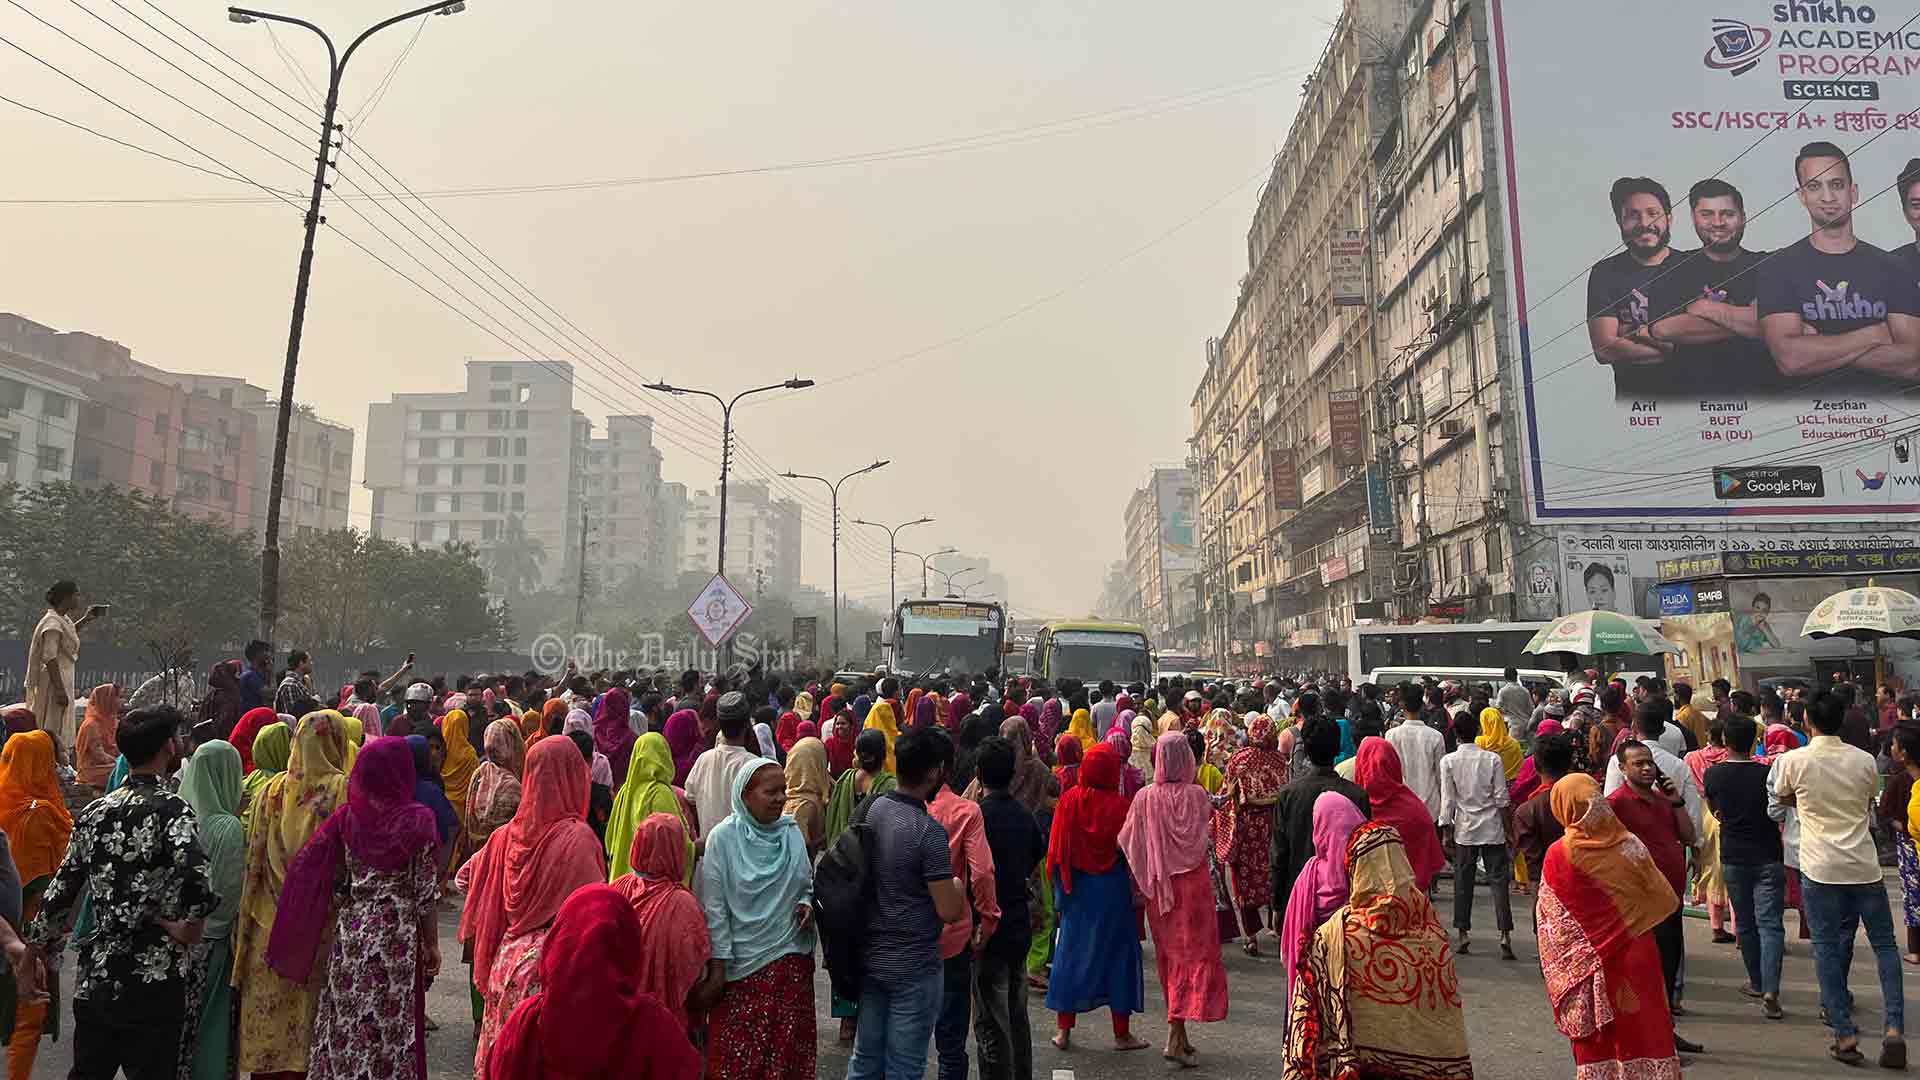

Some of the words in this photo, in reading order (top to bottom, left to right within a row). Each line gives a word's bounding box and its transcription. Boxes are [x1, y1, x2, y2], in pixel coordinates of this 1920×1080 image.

[1774, 0, 1876, 23] shikho
[1778, 30, 1920, 50] ACADEMIC
[1779, 54, 1920, 75] PROGRAM
[1792, 84, 1871, 97] SCIENCE
[1799, 111, 1826, 129] A+
[1834, 106, 1888, 132] প্রস্তুতি
[1803, 292, 1887, 321] shikho
[1632, 401, 1657, 412] Arif
[1700, 401, 1748, 412] Enamul
[1813, 400, 1867, 411] Zeeshan
[1630, 416, 1662, 426] BUET
[1710, 416, 1742, 426] BUET
[1828, 415, 1873, 425] Institute
[1876, 415, 1889, 425] of
[1701, 430, 1722, 441] IBA
[1726, 430, 1753, 441] (DU)
[1802, 429, 1857, 439] Education
[1860, 428, 1886, 439] (UK)
[1747, 479, 1790, 494] Google
[1792, 479, 1817, 494] Play
[1581, 534, 1614, 551] বনানী
[1618, 539, 1643, 551] থানা
[1646, 534, 1716, 552] আওয়ামীলীগ
[1719, 540, 1728, 551] ও
[1759, 540, 1776, 550] ২০
[1780, 540, 1794, 551] নং
[1805, 551, 1849, 569] পুলিশ
